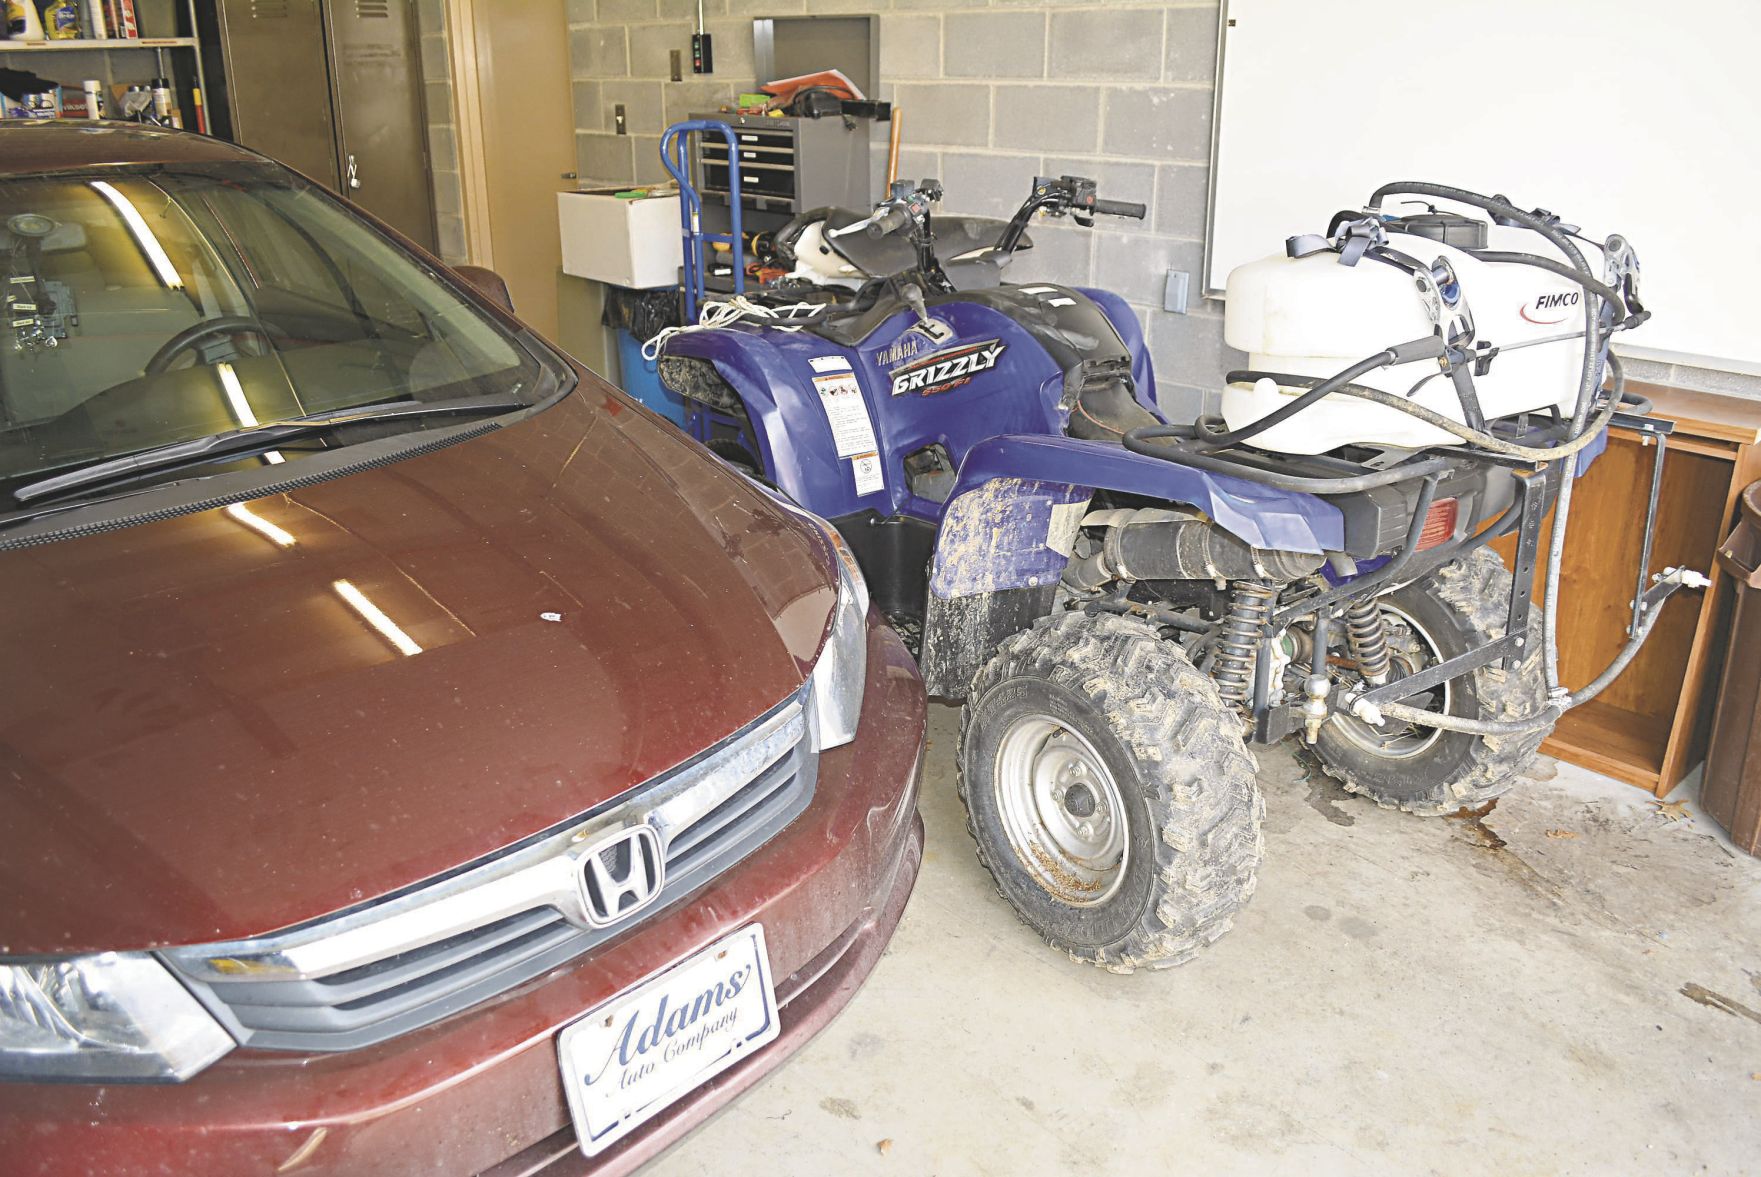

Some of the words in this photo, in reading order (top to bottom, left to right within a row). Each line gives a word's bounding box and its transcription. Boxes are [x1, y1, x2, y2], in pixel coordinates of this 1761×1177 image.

[1535, 292, 1579, 309] FIMCO
[876, 338, 919, 367] YAMAHA
[891, 345, 1006, 397] GRIZZLY
[584, 964, 751, 1086] Adams
[663, 1007, 738, 1064] Company
